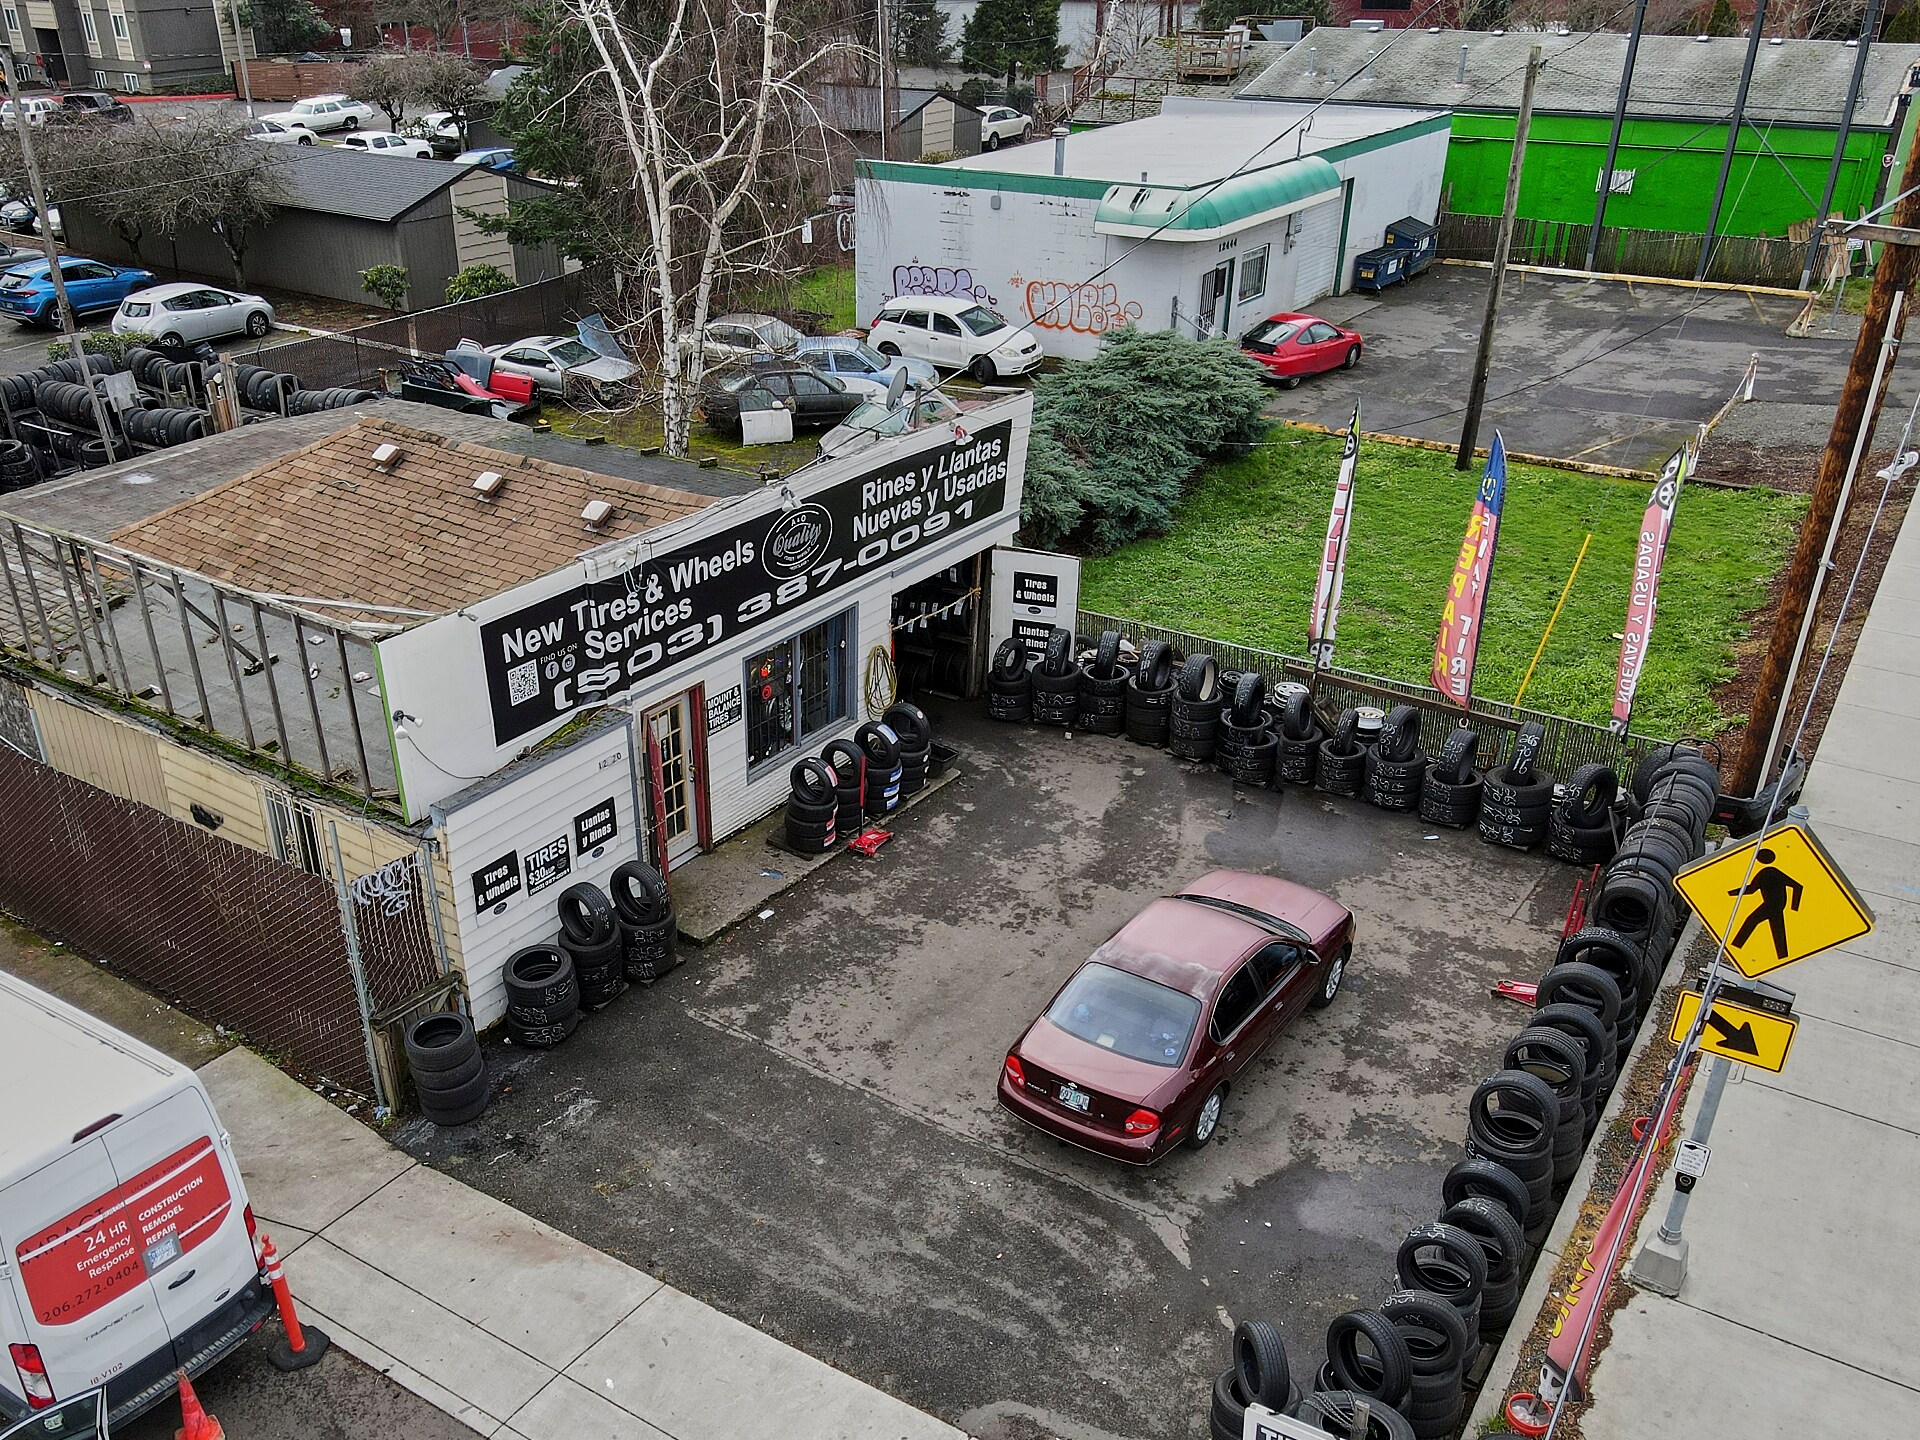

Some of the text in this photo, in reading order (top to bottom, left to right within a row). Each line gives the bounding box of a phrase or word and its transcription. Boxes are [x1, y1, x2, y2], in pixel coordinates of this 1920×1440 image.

[862, 438, 1002, 510] Rines y Llantas
[853, 460, 1007, 542] Nuevas y Usadas
[772, 523, 822, 558] Quality
[1016, 590, 1055, 602] & Wheels
[1024, 578, 1048, 590] Tires
[502, 617, 564, 664] New
[570, 591, 641, 632] Tires
[645, 573, 664, 604] &
[669, 539, 755, 593] Wheels
[553, 500, 974, 711] (503) 387-0091
[584, 597, 693, 660] Services
[1018, 626, 1050, 637] Llantas
[540, 652, 556, 665] FIND
[557, 648, 566, 657] US
[708, 686, 740, 710] MOUNT &
[708, 695, 741, 720] BALANCE
[708, 712, 729, 728] TIRES
[1513, 757, 1532, 774] 16
[1517, 745, 1532, 758] 70
[581, 808, 610, 832] Llantas
[582, 823, 612, 848] y Rines
[526, 838, 568, 871] TIRES
[484, 864, 509, 886] Tires
[478, 894, 485, 906] &
[486, 876, 519, 901] Wheels
[138, 1176, 204, 1222] CONSTRUCTION
[142, 1204, 184, 1234] REMODEL
[83, 1220, 128, 1254] 24 HR
[145, 1222, 177, 1247] REPAIR
[76, 1235, 132, 1272] Emergency
[88, 1247, 135, 1280] Response
[42, 1260, 140, 1323] 206.272.0404
